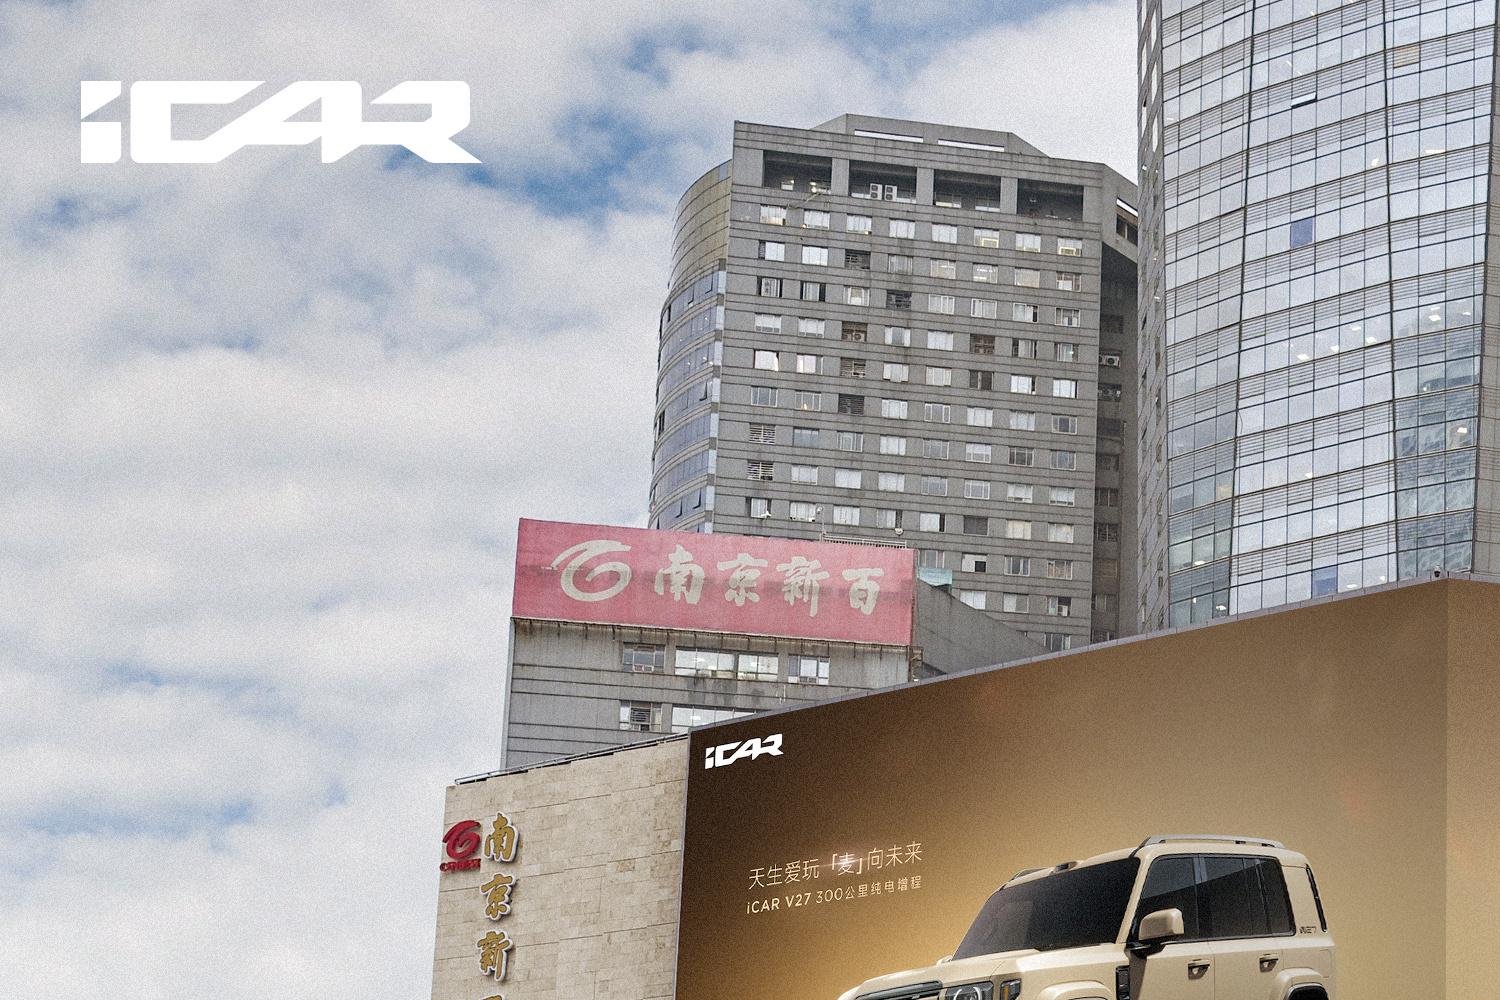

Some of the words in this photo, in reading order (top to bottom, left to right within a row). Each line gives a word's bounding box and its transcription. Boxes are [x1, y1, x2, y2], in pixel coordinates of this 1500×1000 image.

[654, 543, 885, 618] 南京新百
[746, 897, 781, 914] iCAR
[785, 892, 811, 908] V27
[816, 875, 922, 904] 300公里纯电增程
